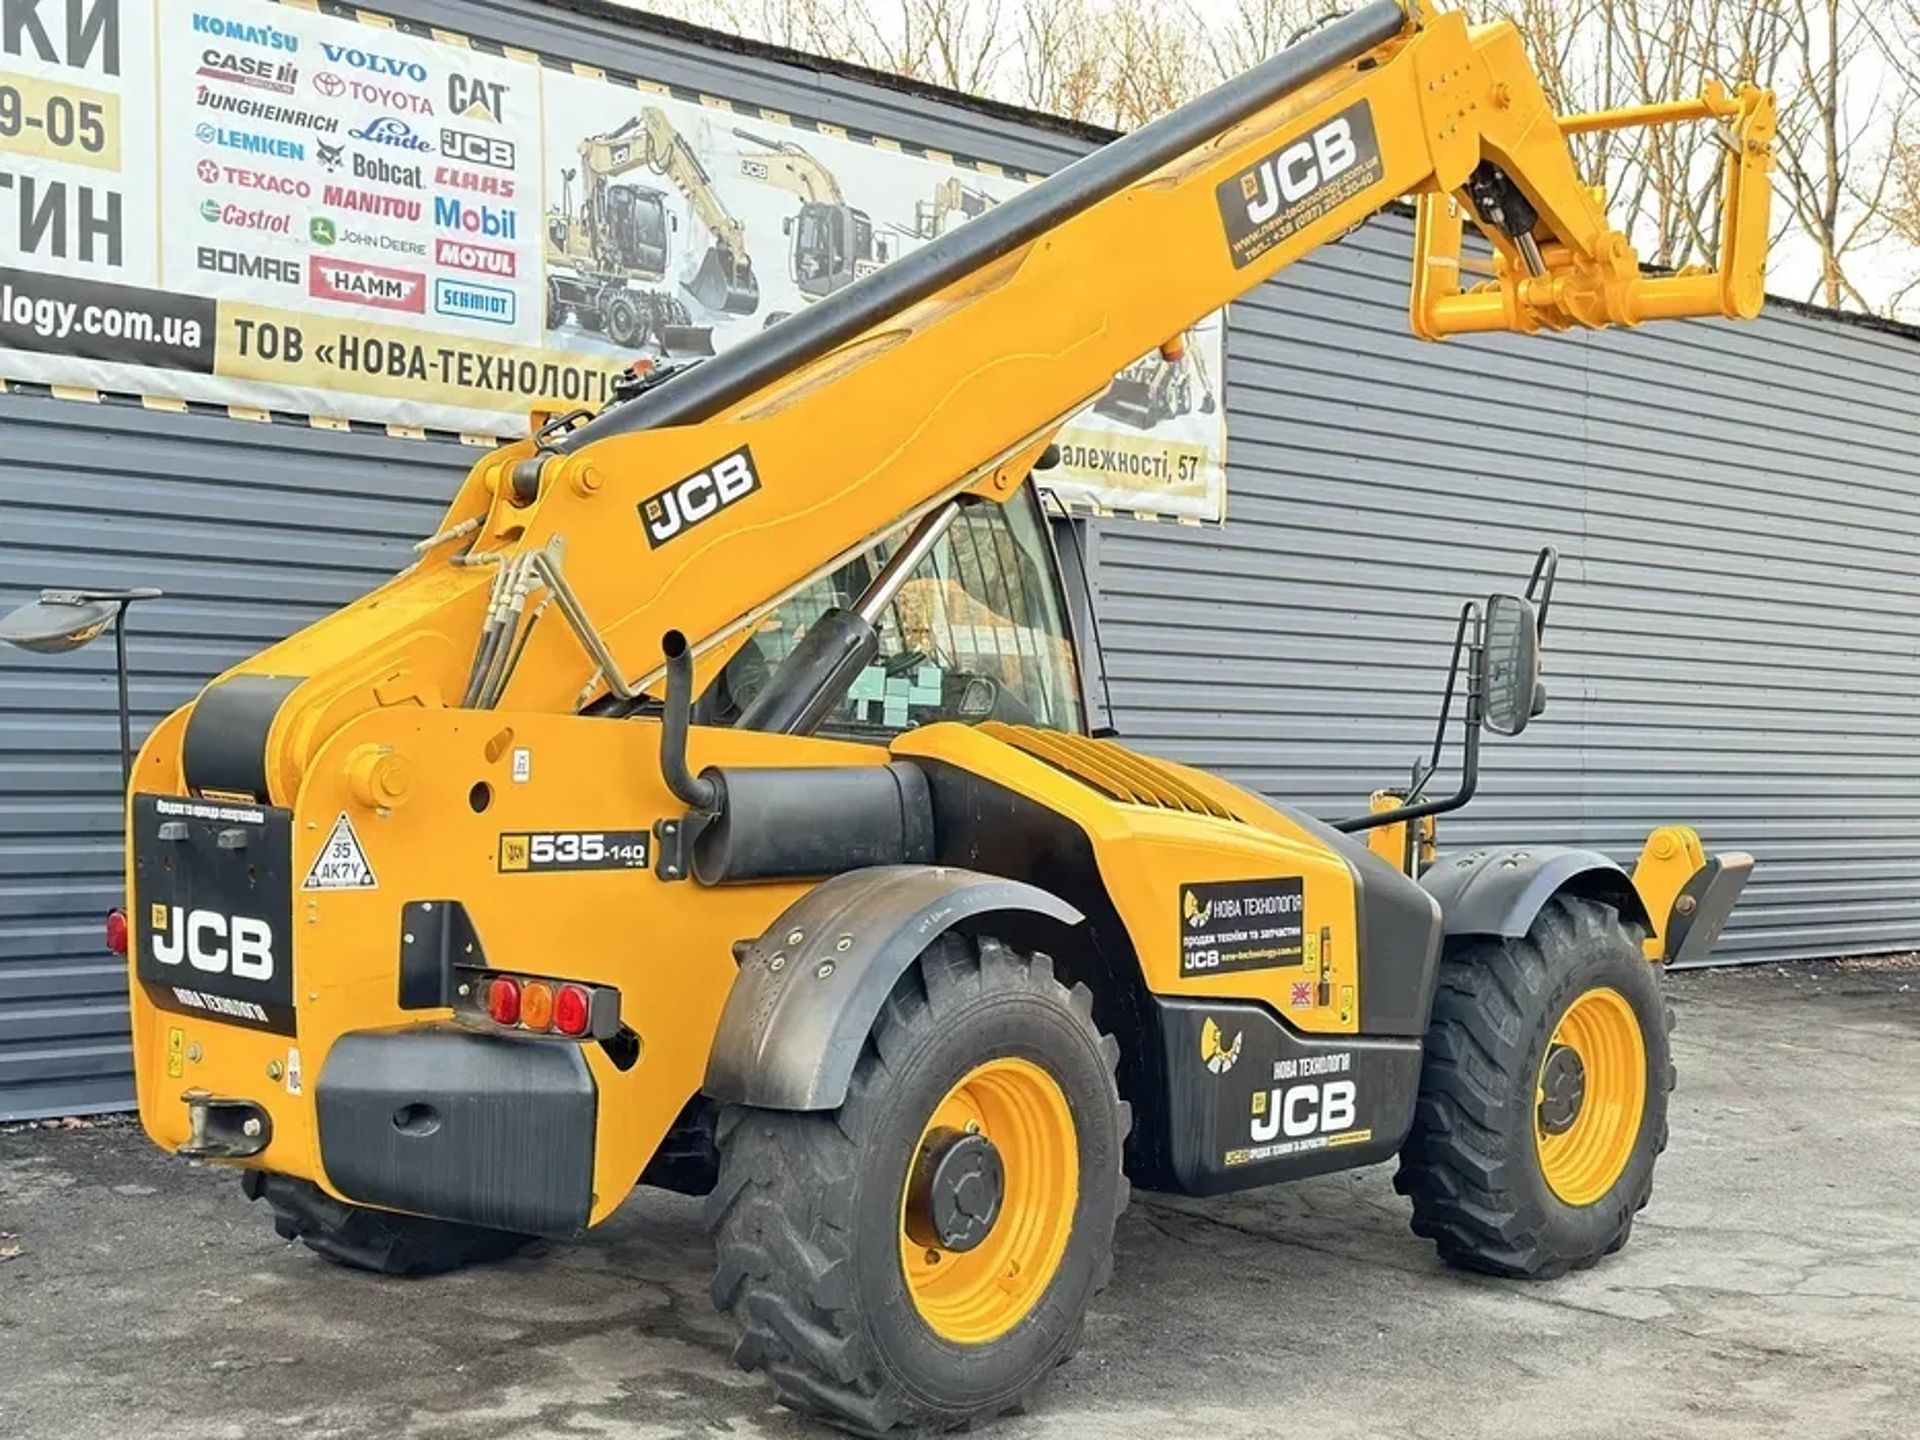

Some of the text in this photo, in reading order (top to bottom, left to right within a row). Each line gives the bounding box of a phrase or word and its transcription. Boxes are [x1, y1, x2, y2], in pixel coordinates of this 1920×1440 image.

[192, 13, 299, 52] KOMATSU
[202, 49, 274, 79] CASE
[319, 41, 428, 82] VOLVO
[196, 86, 339, 134] JUNGHEINRICH
[349, 81, 435, 117] TOYOTA
[448, 72, 505, 124] CAT
[217, 128, 305, 161] LEMKEN
[347, 116, 437, 153] Linde
[442, 129, 515, 169] JCB
[223, 166, 311, 198] TEXACO
[353, 151, 422, 189] Bobcat
[434, 166, 515, 198] CLAAS
[1245, 117, 1357, 224] JCB
[222, 203, 292, 234] Castrol
[322, 184, 422, 222] MANITOU
[434, 196, 516, 239] Mobil
[339, 230, 427, 256] JOHN DEERE
[438, 242, 514, 274] MOTUL
[197, 246, 300, 284] BOMAG
[334, 271, 402, 299] HAMM
[443, 289, 508, 314] SCHMIDT
[3, 285, 201, 348] logy.com.ua
[234, 318, 304, 363] ТОВ
[1178, 454, 1199, 482] 57
[648, 453, 755, 541] JCB
[333, 842, 351, 859] 35
[1213, 899, 1242, 919] НОВА
[152, 905, 274, 981] JCB
[1185, 949, 1219, 969] JCB
[1250, 1080, 1357, 1142] JCB
